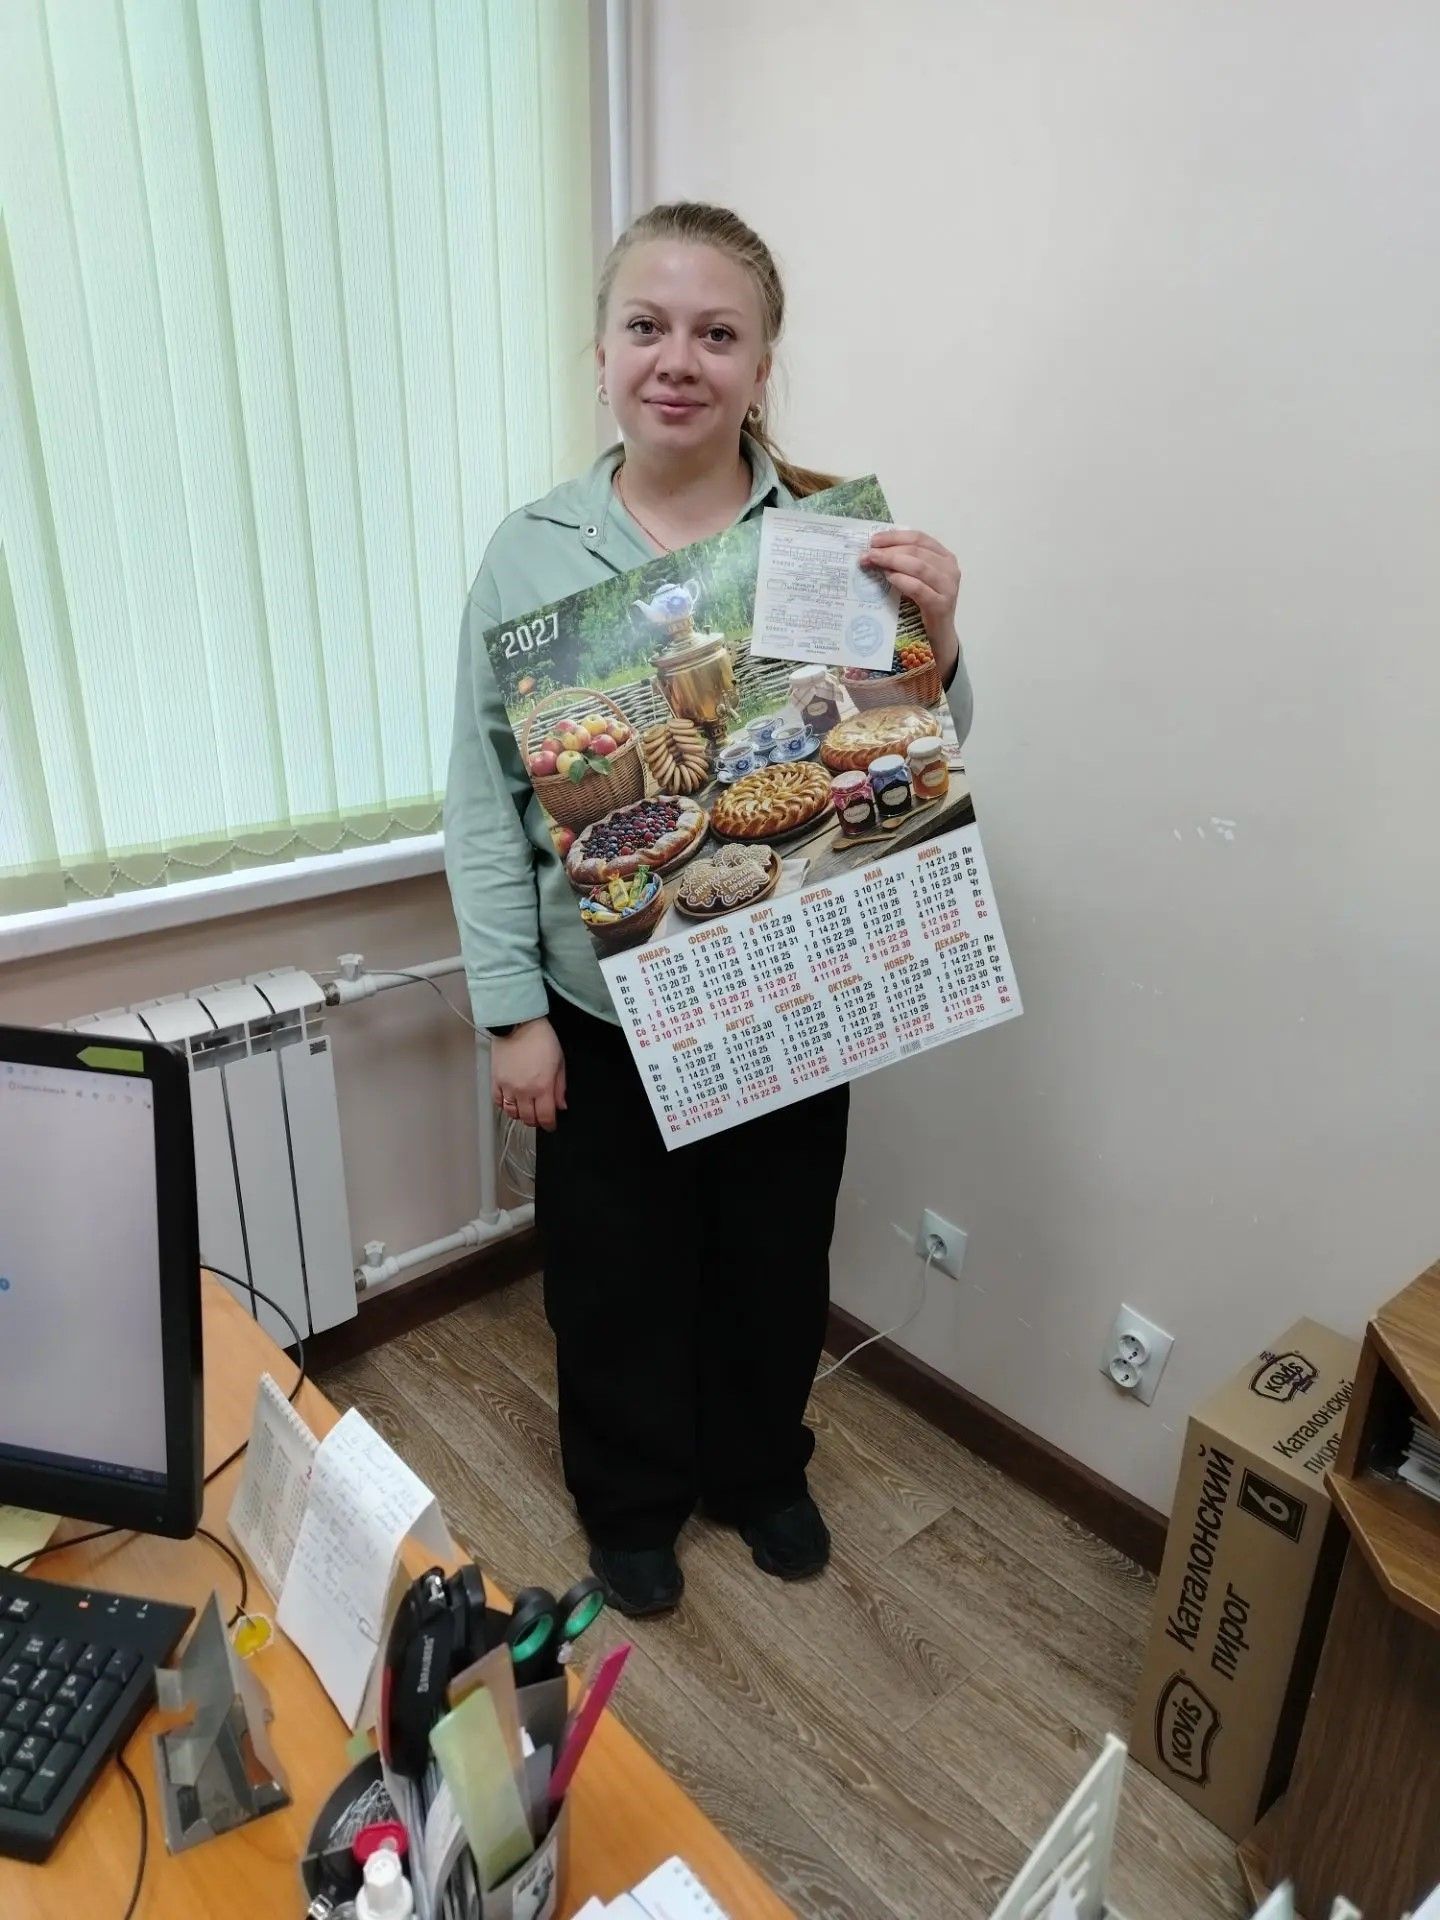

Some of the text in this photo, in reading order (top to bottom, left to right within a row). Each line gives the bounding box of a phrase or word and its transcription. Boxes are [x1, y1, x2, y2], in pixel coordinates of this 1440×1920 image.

[501, 613, 559, 659] 2027
[918, 846, 941, 861] ИЮНЬ
[925, 860, 935, 869] 14
[936, 855, 946, 865] 21
[948, 851, 957, 861] 28
[864, 868, 883, 882] МАЙ
[928, 870, 938, 879] 15
[939, 866, 949, 876] 22
[950, 862, 960, 871] 29
[862, 885, 872, 894] 10
[873, 880, 882, 890] 17
[884, 876, 894, 886] 24
[896, 872, 905, 881] 31
[801, 888, 832, 905] АПРЕЛЬ
[812, 903, 822, 913] 12
[823, 899, 833, 908] 19
[835, 895, 845, 905] 26
[750, 908, 773, 923] МАРТ
[759, 922, 769, 932] 15
[770, 918, 780, 928] 22
[782, 914, 792, 924] 29
[815, 914, 825, 924] 13
[826, 910, 837, 920] 20
[838, 906, 847, 916] 27
[688, 926, 728, 944] ФЕВРАЛЬ
[710, 940, 721, 949] 15
[722, 936, 733, 945] 22
[762, 933, 772, 943] 16
[773, 929, 784, 939] 23
[785, 925, 796, 934] 30
[935, 932, 970, 951] ДЕКАБРЬ
[638, 947, 670, 963] ЯНВАРЬ
[714, 951, 724, 960] 16
[725, 946, 736, 956] 23
[948, 946, 958, 955] 13
[959, 942, 969, 952] 20
[970, 938, 979, 948] 27
[649, 962, 660, 971] 11
[661, 957, 672, 966] 18
[673, 953, 684, 963] 25
[884, 953, 914, 971] НОЯБРЬ
[898, 966, 908, 975] 15
[909, 962, 919, 972] 22
[920, 958, 929, 967] 29
[951, 957, 960, 966] 14
[961, 953, 971, 962] 21
[973, 949, 982, 958] 28
[828, 974, 863, 993] ОКТЯБРЬ
[901, 977, 910, 986] 16
[911, 972, 921, 982] 23
[922, 968, 932, 977] 30
[841, 990, 850, 999] 11
[852, 986, 861, 994] 18
[863, 981, 873, 990] 25
[775, 994, 814, 1013] СЕНТЯБРЬ
[844, 1000, 854, 1009] 12
[854, 996, 864, 1004] 19
[866, 991, 875, 1000] 26
[791, 1009, 801, 1018] 13
[801, 1005, 812, 1015] 20
[812, 1001, 821, 1010] 27
[726, 1015, 755, 1032] АВГУСТ
[740, 1028, 751, 1037] 16
[751, 1024, 762, 1034] 23
[762, 1020, 772, 1029] 30
[794, 1019, 804, 1028] 14
[804, 1015, 814, 1025] 21
[816, 1011, 826, 1020] 28
[672, 1037, 697, 1051] ИЮЛЬ
[681, 1050, 692, 1059] 12
[693, 1046, 703, 1055] 19
[703, 1042, 714, 1052] 26
[733, 1043, 743, 1052] 10
[744, 1038, 753, 1048] 17
[755, 1035, 765, 1044] 24
[765, 1031, 775, 1040] 31
[1247, 1485, 1290, 1522] 6
[1165, 1444, 1234, 1651] Каталонский
[1211, 1582, 1250, 1681] пирог
